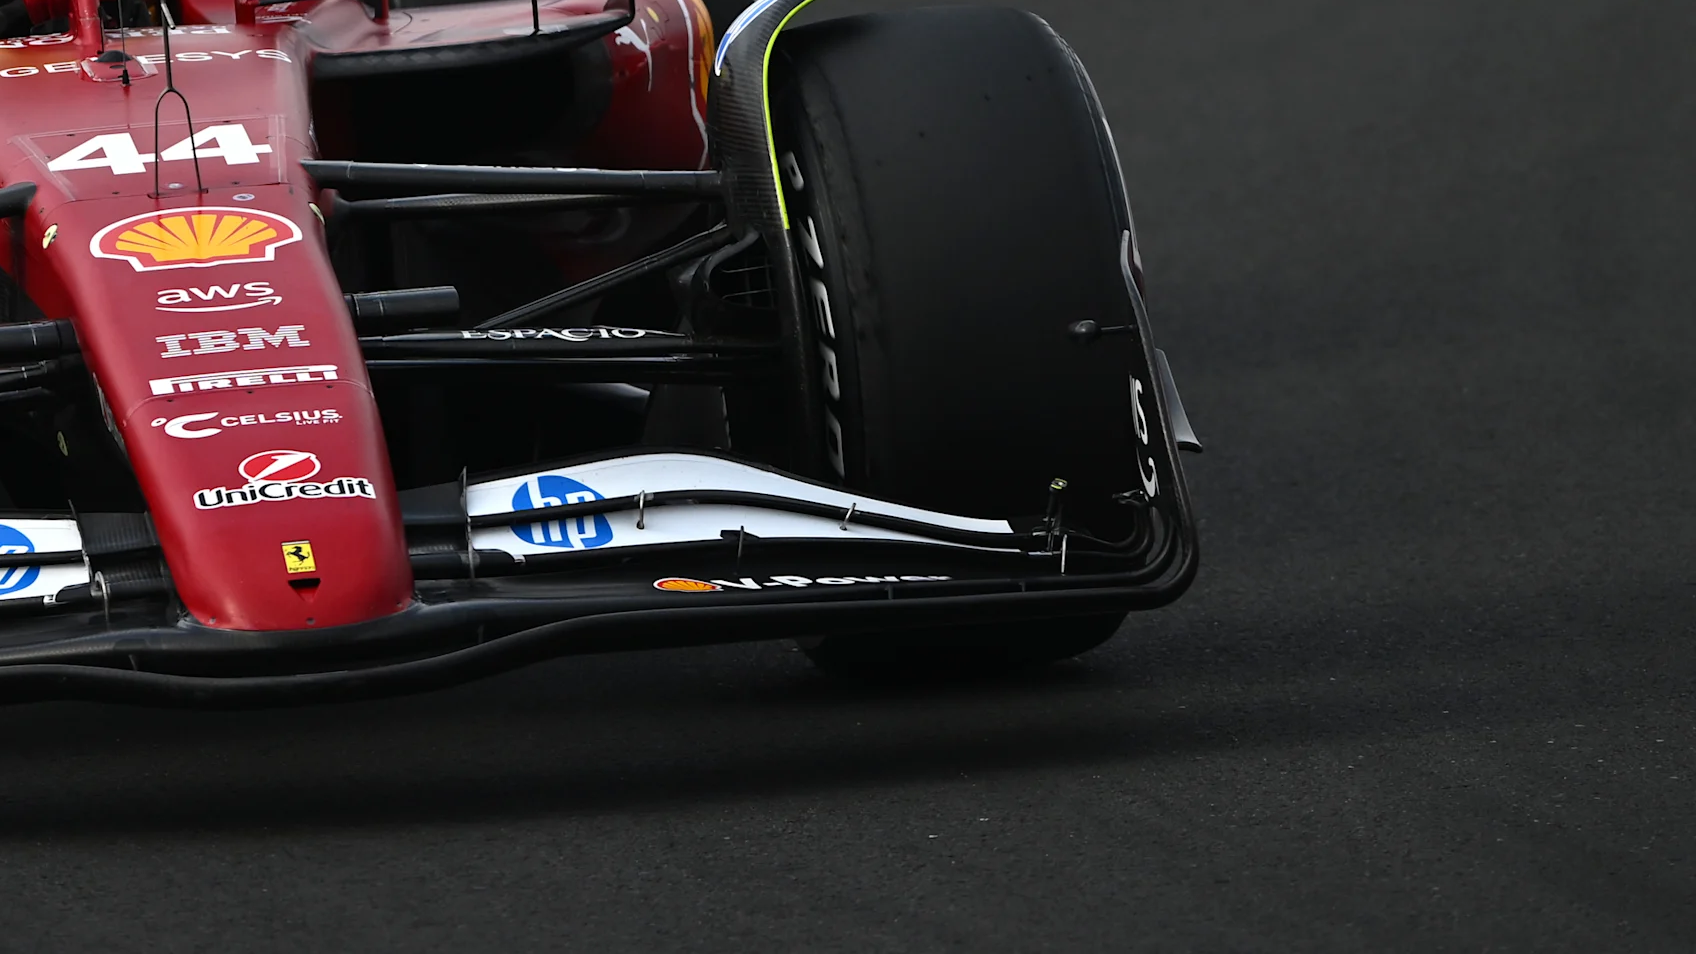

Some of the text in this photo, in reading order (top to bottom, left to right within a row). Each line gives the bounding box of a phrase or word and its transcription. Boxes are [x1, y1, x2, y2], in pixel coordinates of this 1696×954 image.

[47, 123, 274, 176] 44
[156, 281, 276, 306] aws
[155, 325, 311, 359] IBM
[148, 364, 339, 396] PIRELLI
[195, 478, 373, 509] UniCredit
[522, 475, 601, 549] hp
[710, 574, 953, 590] V-Power
